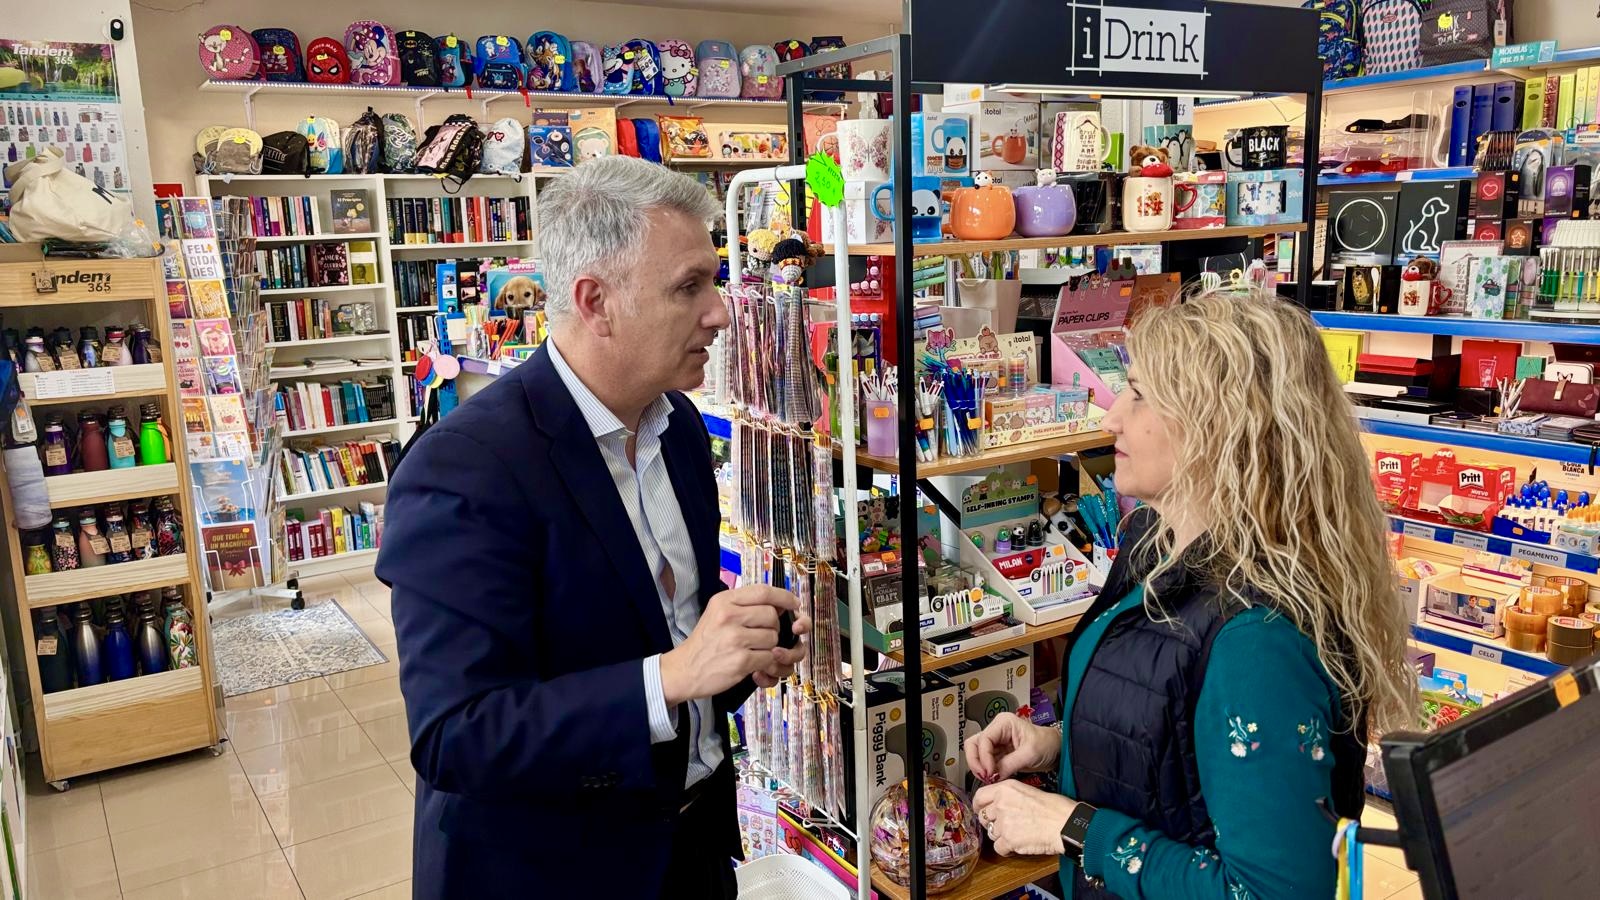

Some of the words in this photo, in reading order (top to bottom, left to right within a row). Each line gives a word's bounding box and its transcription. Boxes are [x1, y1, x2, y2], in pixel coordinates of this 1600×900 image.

[11, 43, 73, 57] Tandem
[54, 56, 73, 65] 365
[1248, 136, 1280, 153] BLACK
[87, 282, 111, 293] 365
[1057, 315, 1084, 326] PAPER
[1085, 311, 1110, 323] CLIPS
[1380, 461, 1399, 470] Pritt
[1562, 464, 1585, 474] BLANCA
[1461, 472, 1481, 483] Pritt
[1471, 489, 1489, 497] NUEVO
[966, 499, 1007, 513] SELF-INKING
[1008, 493, 1035, 504] STAMPS
[1518, 548, 1559, 562] PEGAMENTO
[998, 557, 1023, 570] MILAN
[890, 639, 902, 648] 3D
[1478, 650, 1495, 659] CELO
[872, 711, 886, 752] Piggy
[876, 753, 887, 787] Bank
